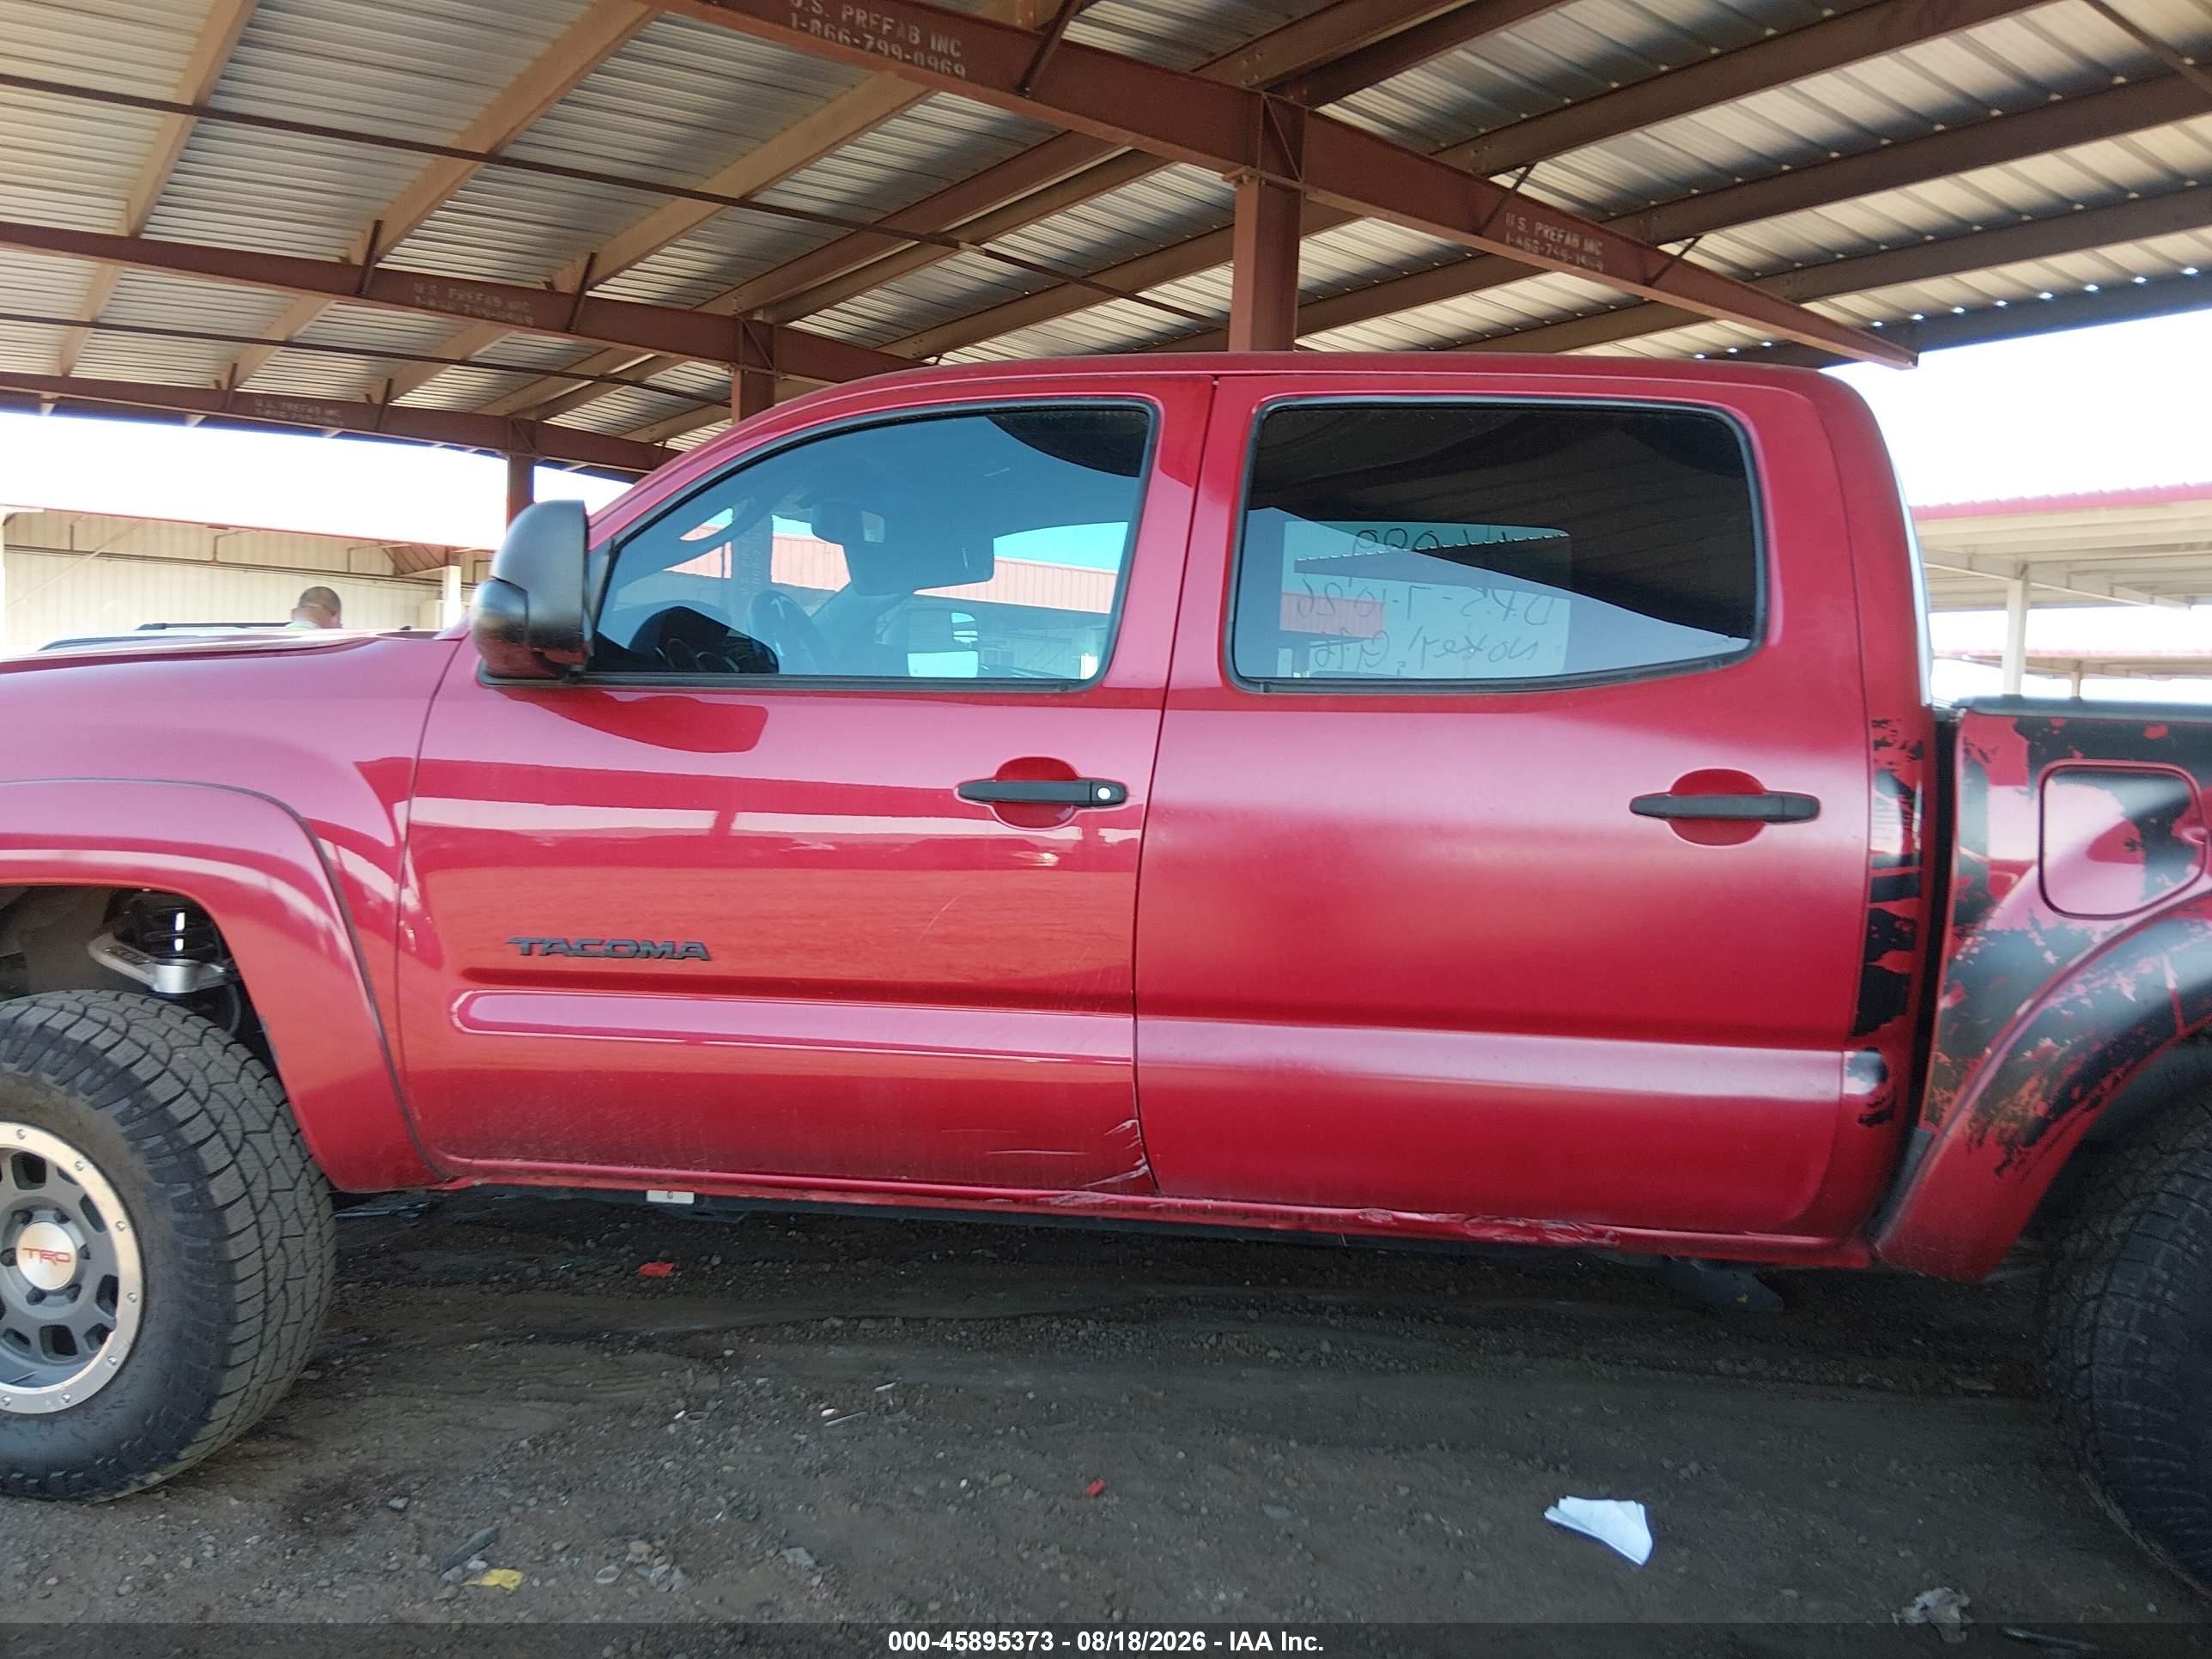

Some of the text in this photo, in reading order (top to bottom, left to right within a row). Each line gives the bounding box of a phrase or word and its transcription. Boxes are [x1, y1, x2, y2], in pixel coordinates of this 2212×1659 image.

[842, 4, 921, 45] PREFAB
[930, 33, 963, 58] INC
[507, 936, 713, 962] TACOMA
[22, 1247, 71, 1266] TRD
